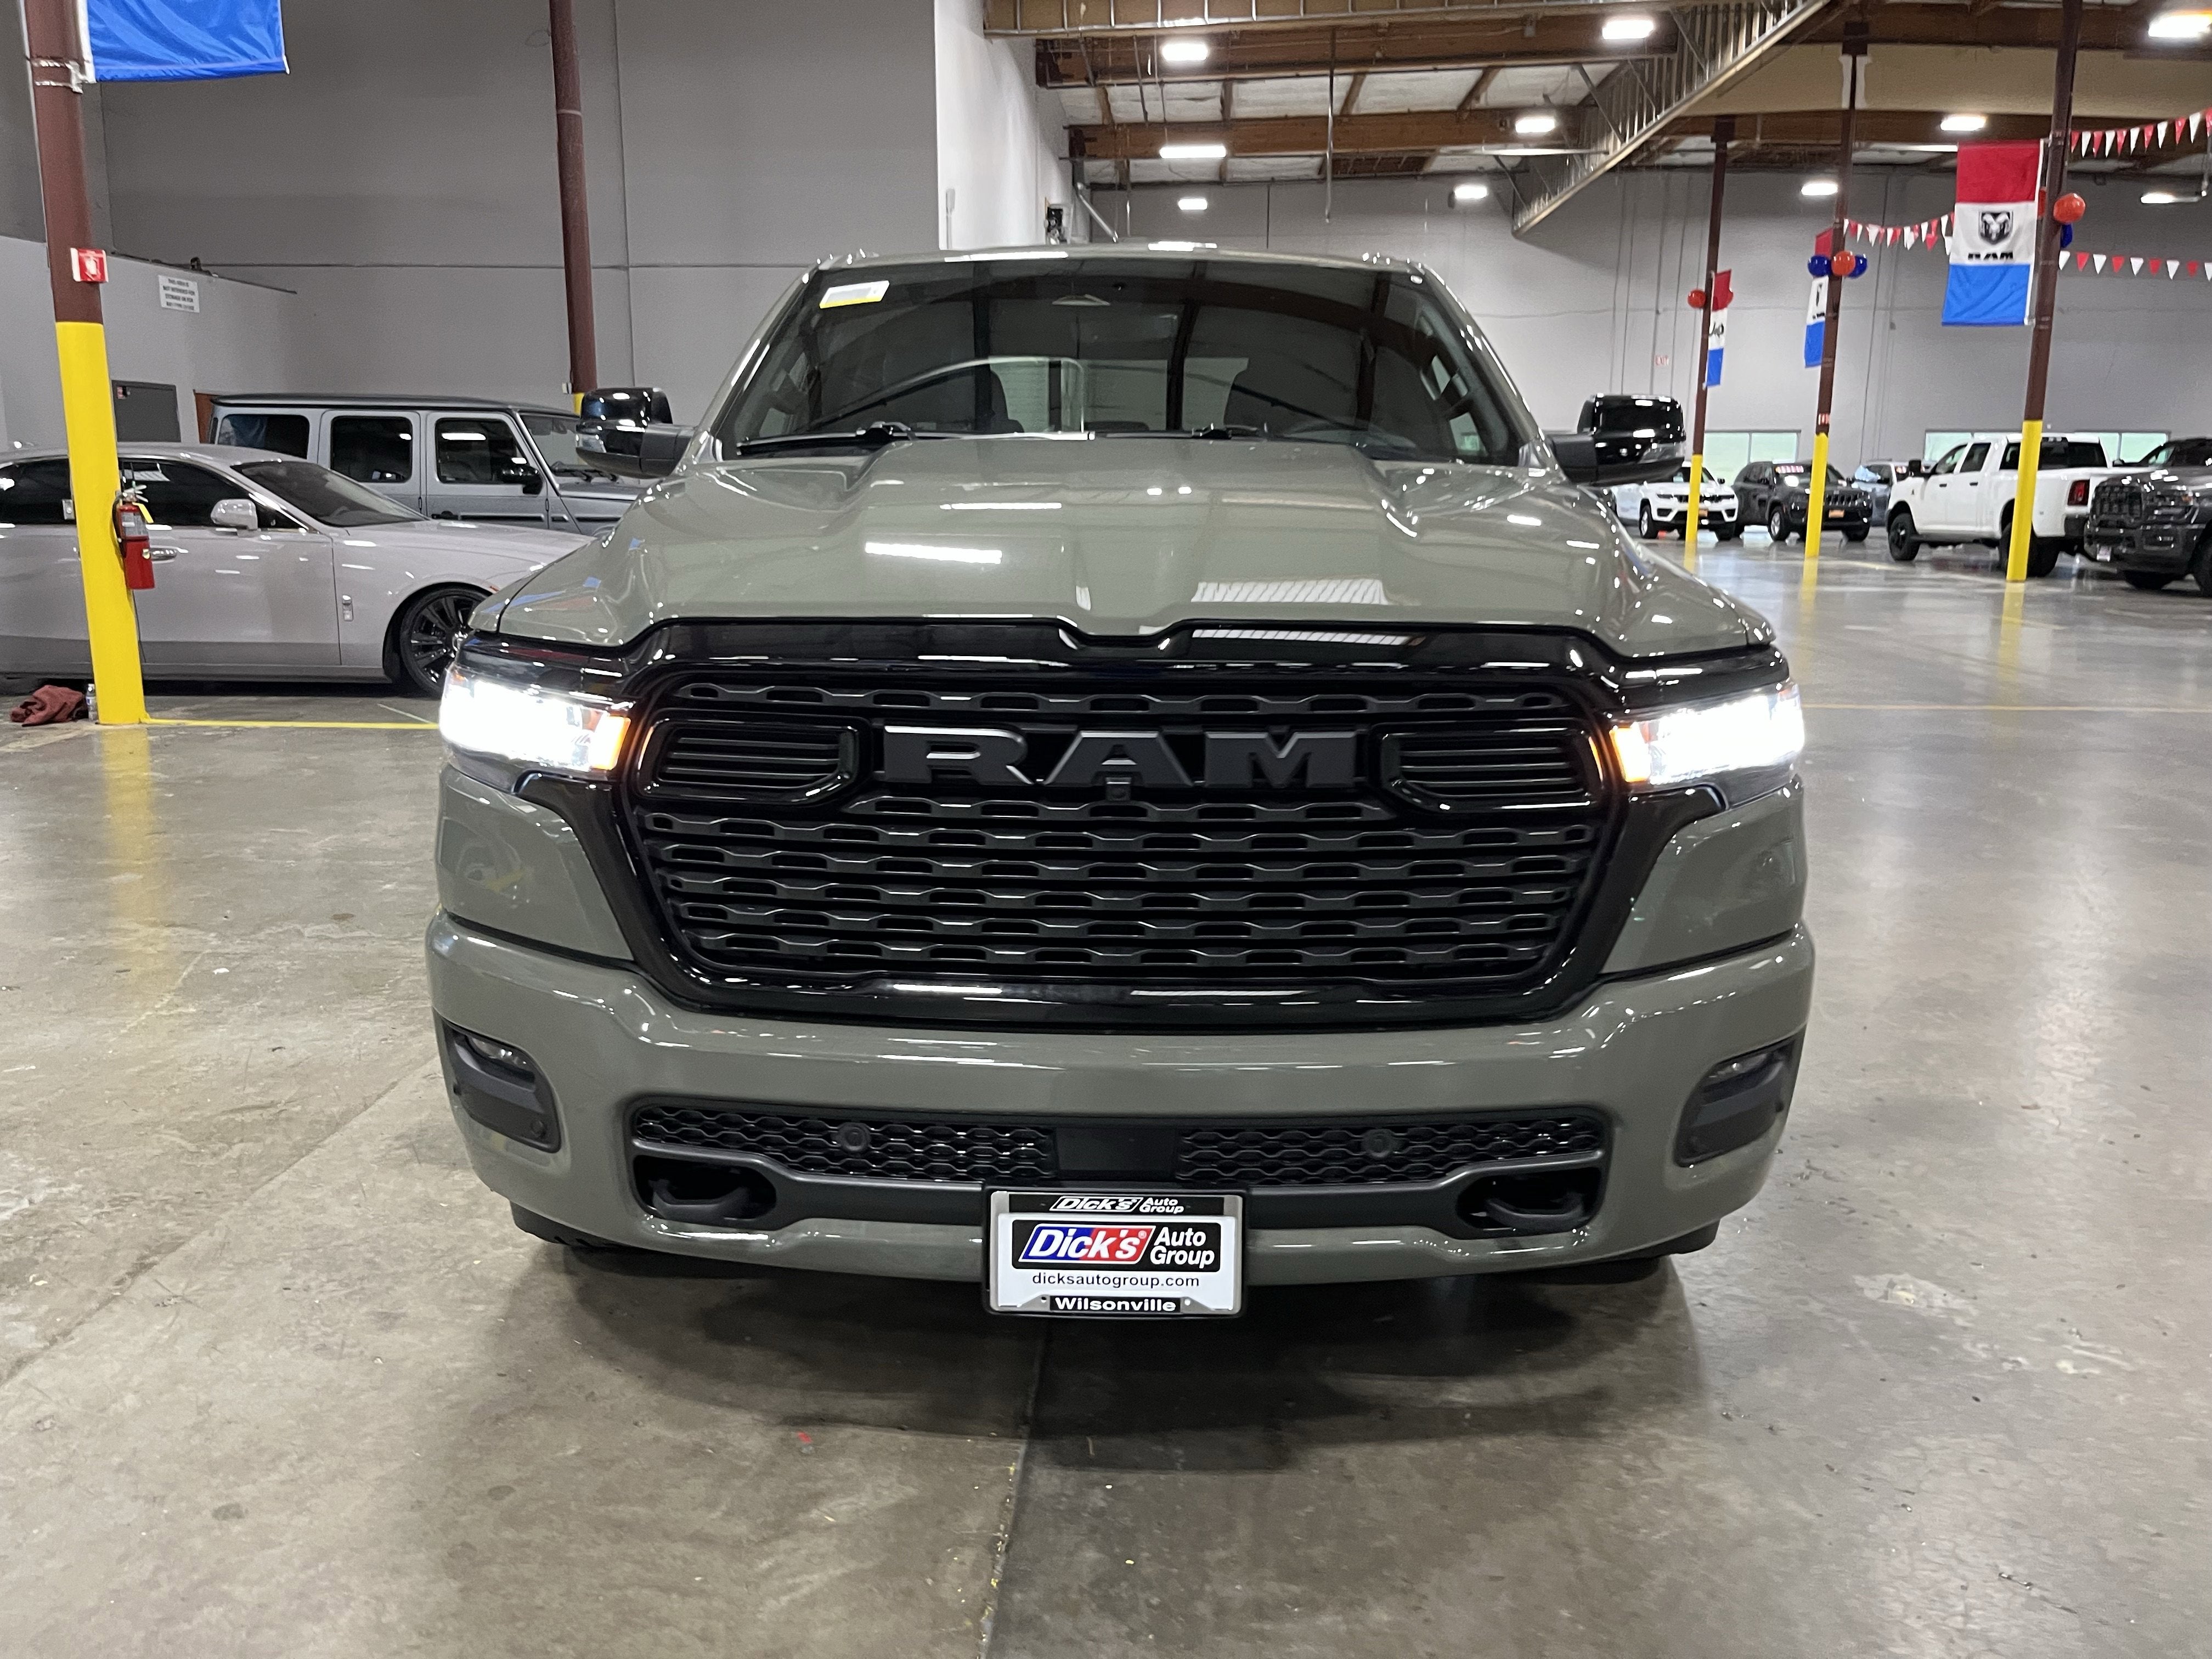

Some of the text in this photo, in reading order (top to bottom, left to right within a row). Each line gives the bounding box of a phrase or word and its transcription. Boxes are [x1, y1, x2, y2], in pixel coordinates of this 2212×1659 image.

[884, 725, 1357, 789] RAM
[1056, 1197, 1133, 1210] Dick's
[1139, 1204, 1184, 1214] Group
[1144, 1197, 1178, 1206] Auto
[1028, 1228, 1141, 1259] Dick's
[1154, 1227, 1206, 1246] Auto
[1150, 1245, 1215, 1269] Group
[1032, 1272, 1200, 1289] dicksautogroup.com
[1054, 1297, 1177, 1312] Wilsonville
